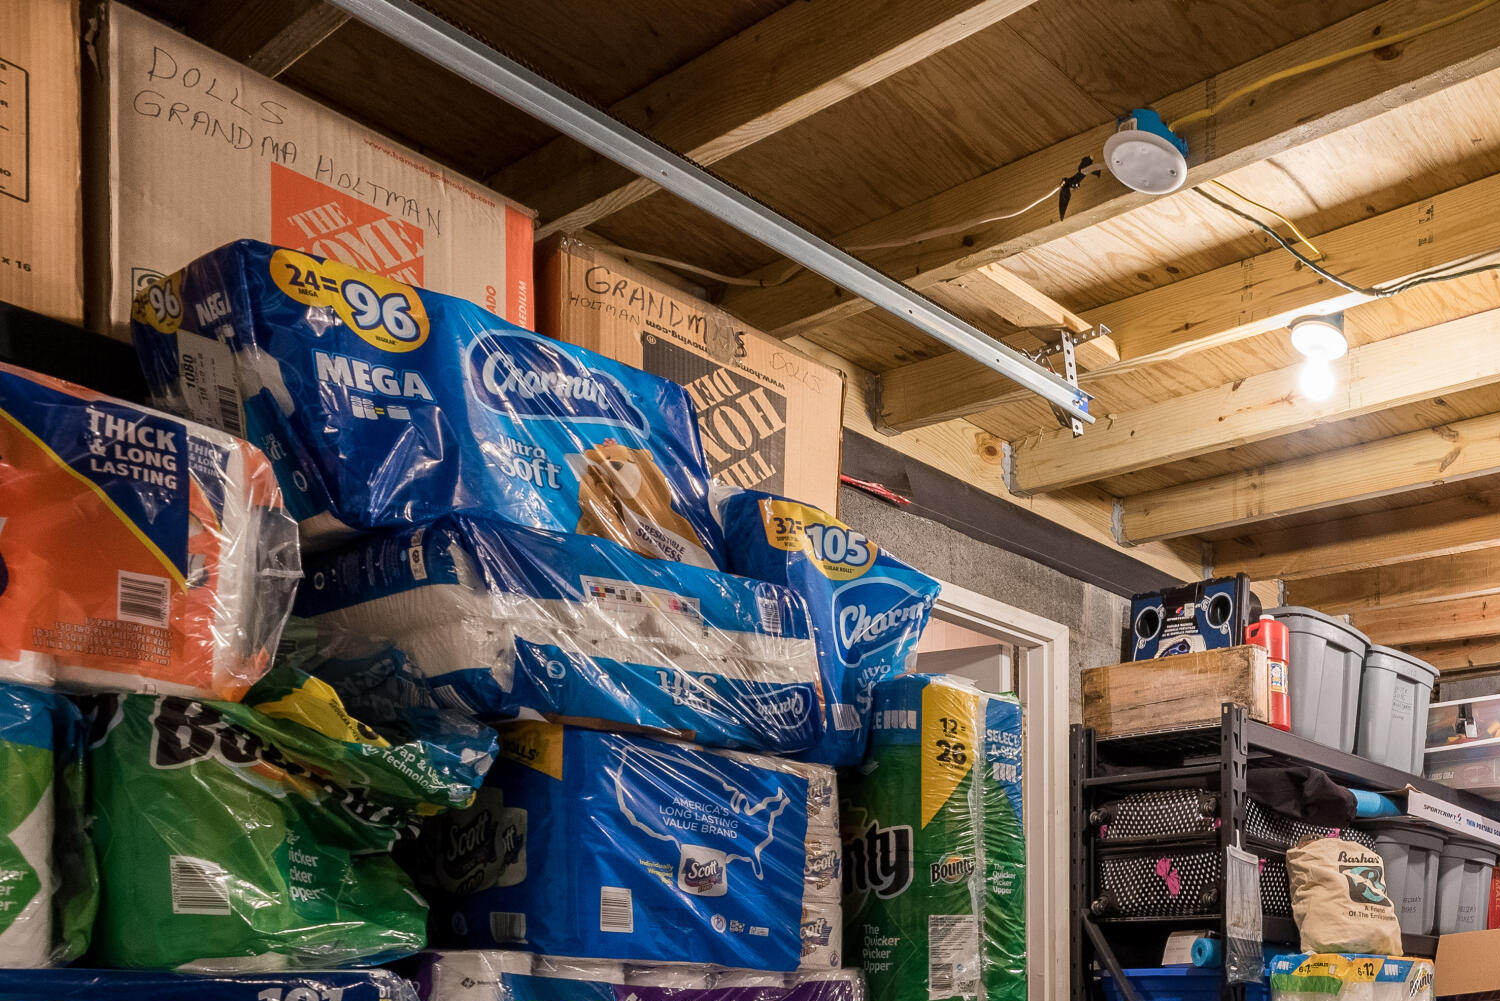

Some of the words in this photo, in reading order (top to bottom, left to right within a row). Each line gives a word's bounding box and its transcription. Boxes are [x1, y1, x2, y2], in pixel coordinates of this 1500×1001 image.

[148, 47, 287, 125] DOLLS
[133, 90, 297, 164] GRANDMA
[315, 154, 441, 237] HOLTMAN
[287, 201, 351, 239] THE
[15, 260, 32, 272] 16
[313, 349, 437, 403] MEGA
[482, 350, 611, 411] Charmin
[86, 405, 178, 453] THICK
[114, 443, 178, 473] LONG
[499, 434, 547, 459] Ultra
[90, 457, 178, 491] LASTING
[659, 804, 693, 820] LONG
[694, 811, 739, 830] LASTING
[672, 796, 730, 817] AMERICA'S
[662, 817, 698, 833] VALUE
[700, 824, 738, 839] BRAND
[688, 859, 719, 877] Scott
[863, 923, 880, 937] The
[863, 935, 900, 948] Quicker
[862, 948, 892, 960] Picker
[863, 960, 893, 974] Upper
